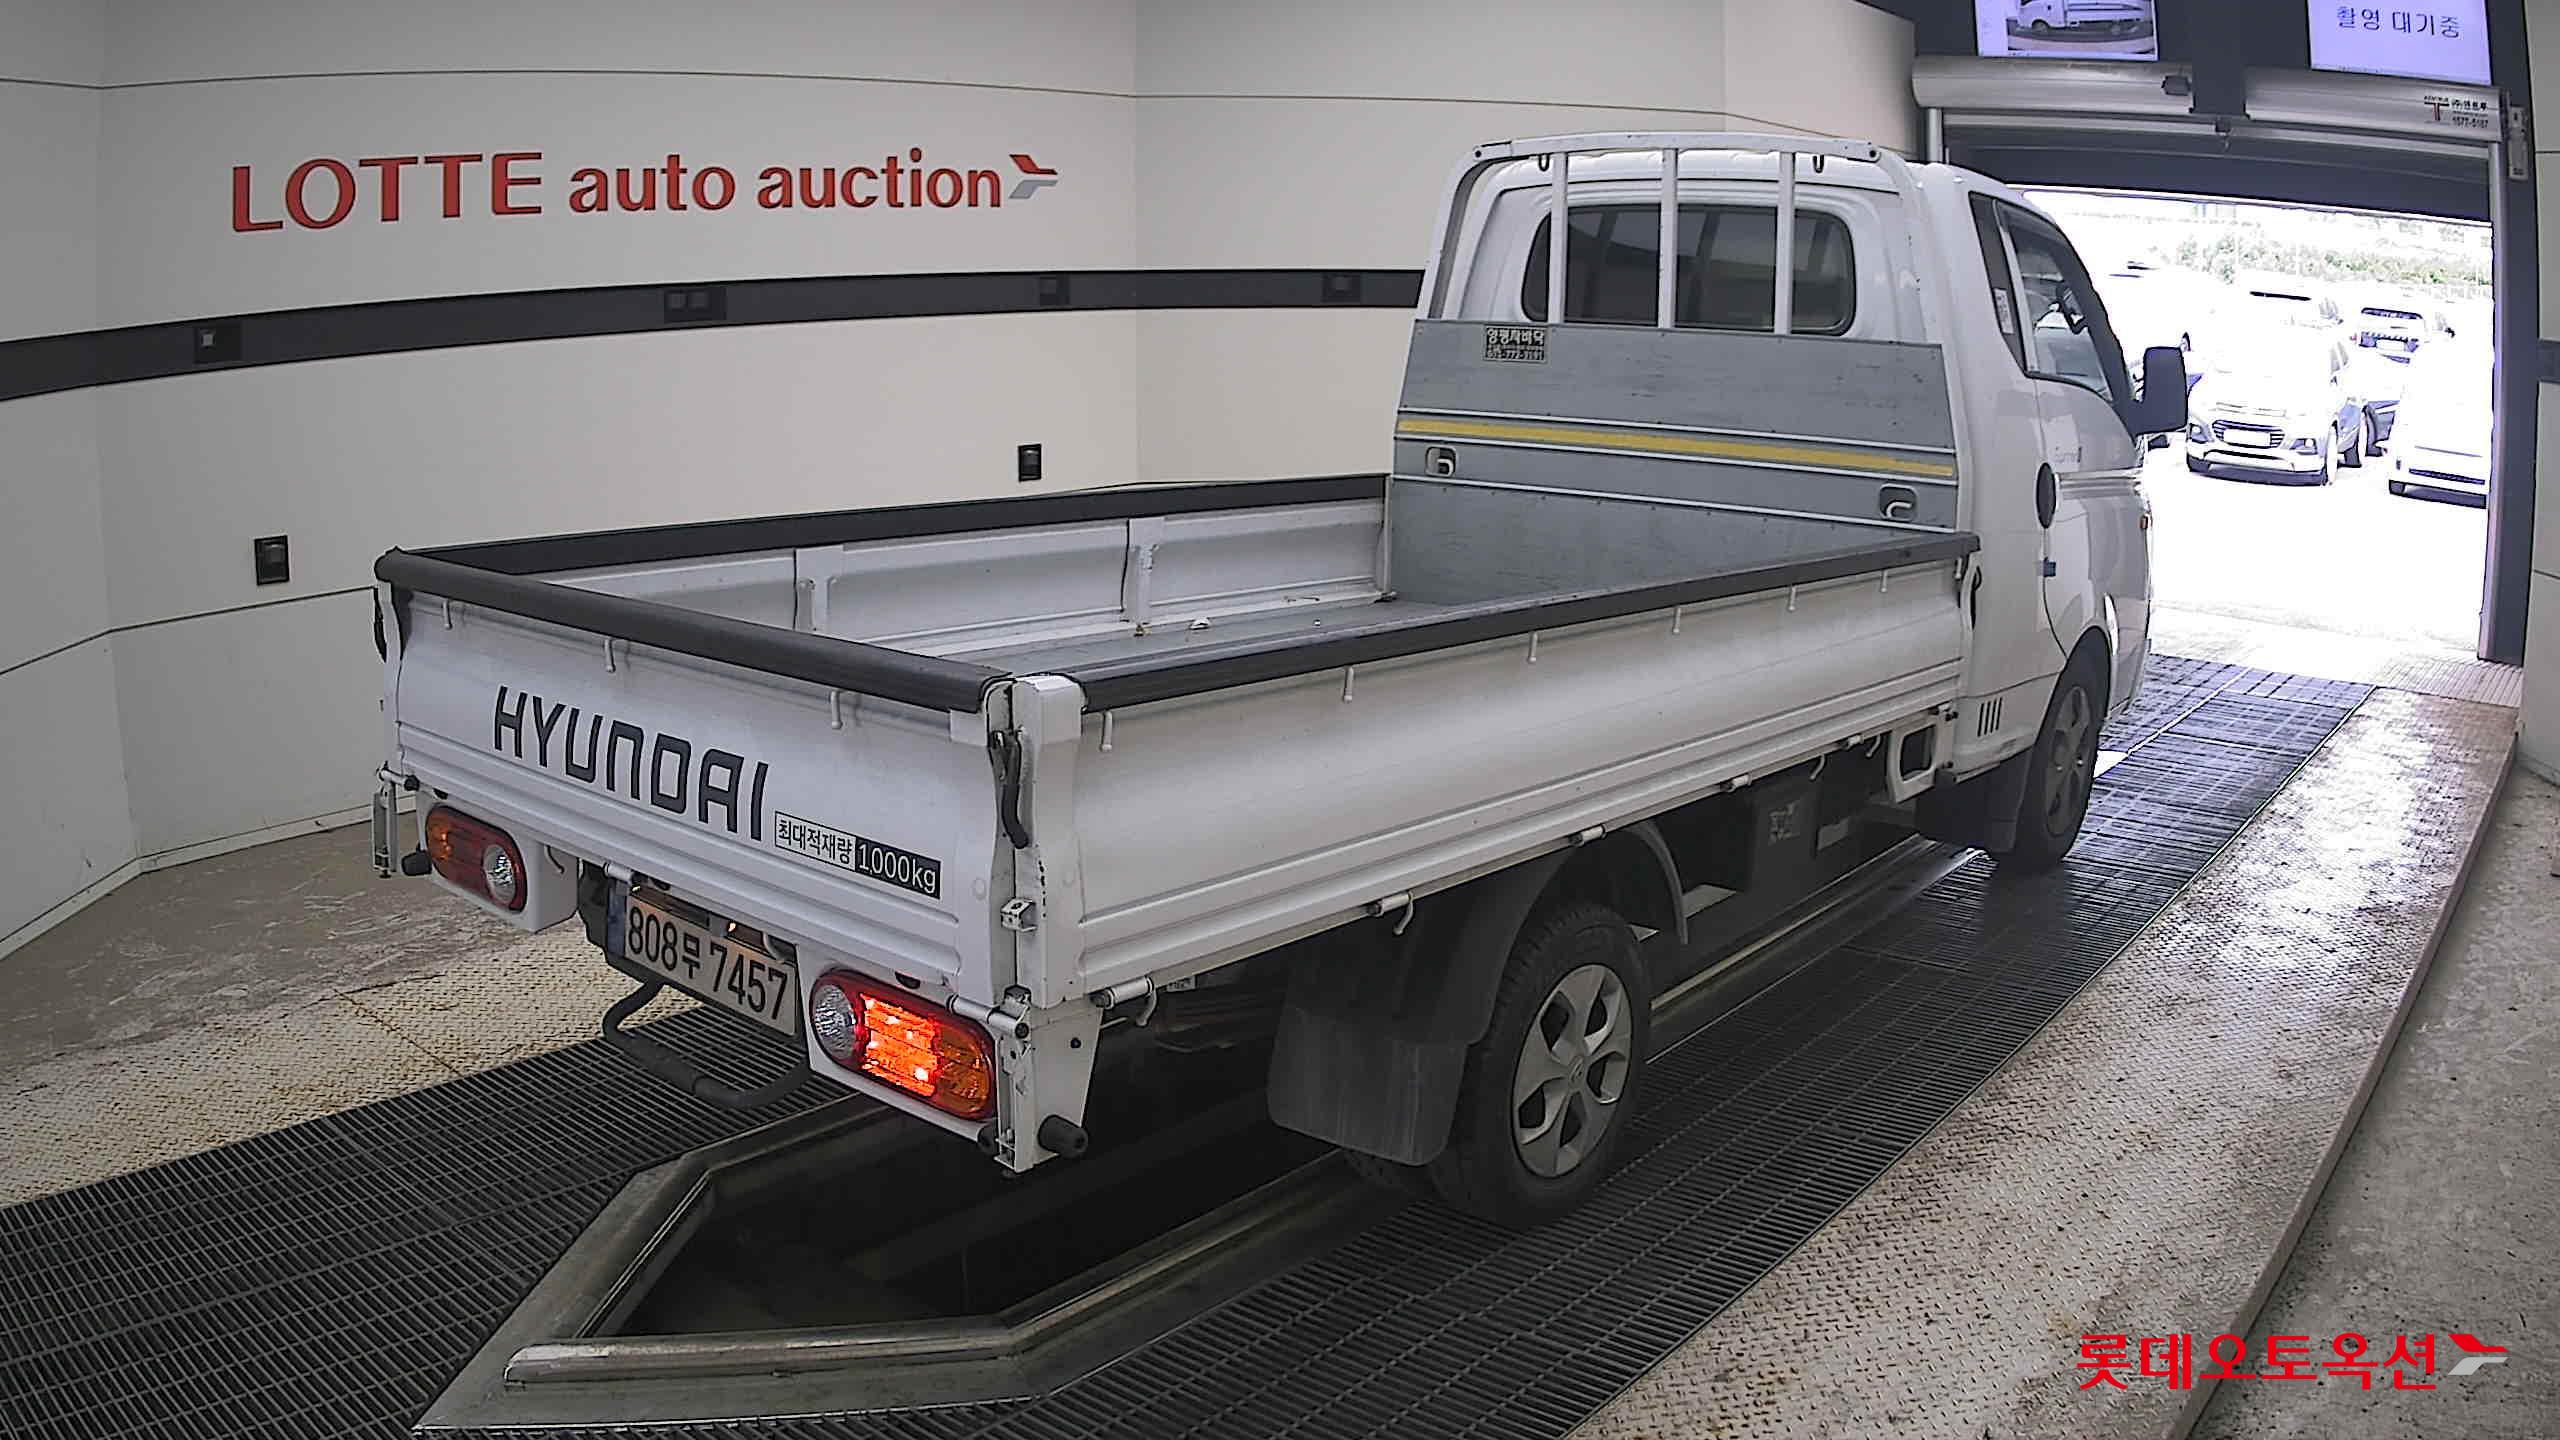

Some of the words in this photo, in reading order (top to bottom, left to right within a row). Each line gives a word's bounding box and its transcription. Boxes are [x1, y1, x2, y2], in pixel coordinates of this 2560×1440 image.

[2336, 6, 2381, 31] 촬영
[2392, 11, 2461, 39] 대기중
[231, 151, 543, 233] LOTTE
[568, 153, 735, 213] auto
[757, 147, 1002, 210] auction
[493, 684, 769, 842] HYUNDAI
[778, 818, 853, 865] 최대적재량
[710, 941, 788, 1020] 7457
